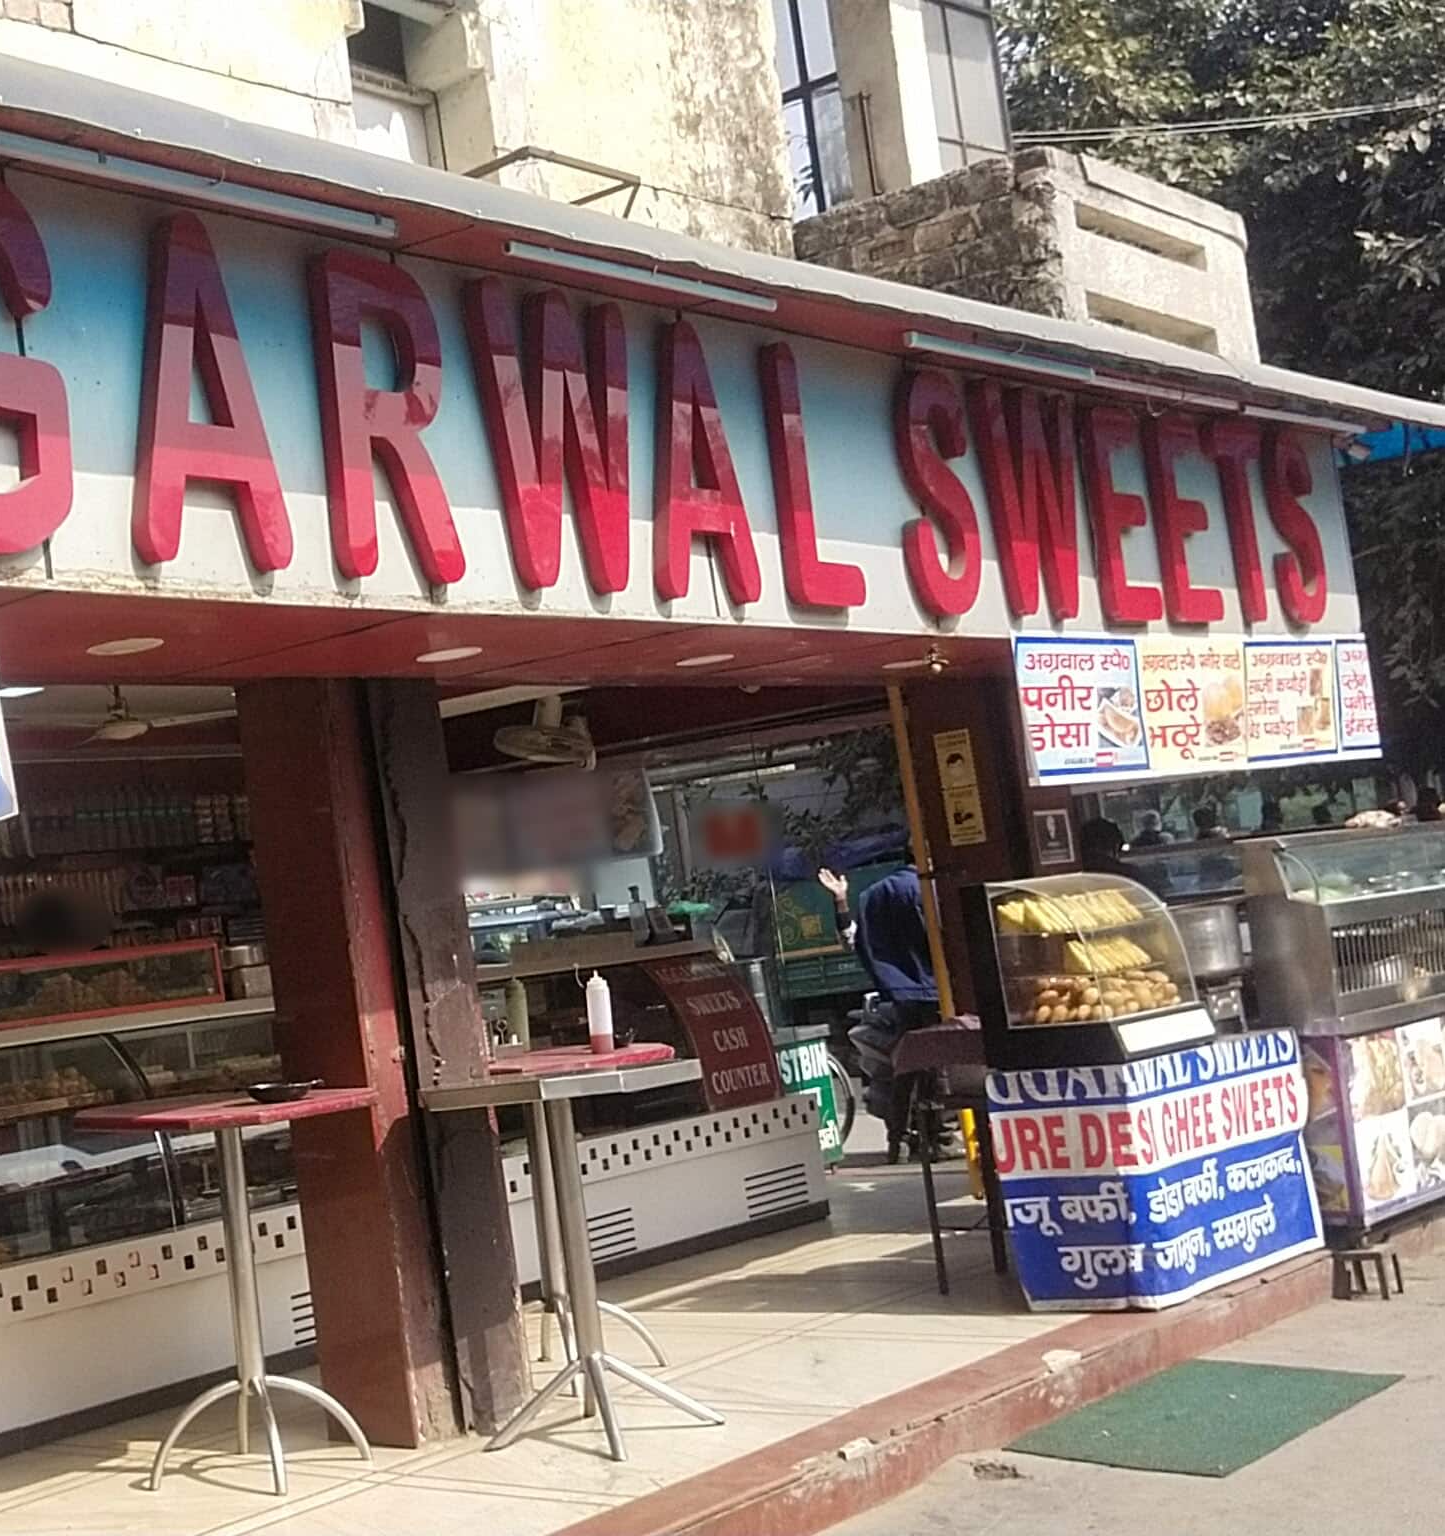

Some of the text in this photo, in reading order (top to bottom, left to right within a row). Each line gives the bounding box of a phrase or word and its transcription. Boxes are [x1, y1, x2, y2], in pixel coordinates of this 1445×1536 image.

[894, 367, 1327, 625] SWEETS
[1024, 653, 1094, 674] अग्रवाल
[1021, 674, 1094, 711] पनीर
[1144, 678, 1201, 712] छोले
[1028, 713, 1091, 751] डोसा
[1149, 714, 1202, 760] भठूरे
[712, 1026, 749, 1052] CASH
[711, 1063, 771, 1094] COUNTER
[776, 1041, 829, 1085] STBIN
[989, 1072, 1298, 1174] URE DESI GHEE SWEETS
